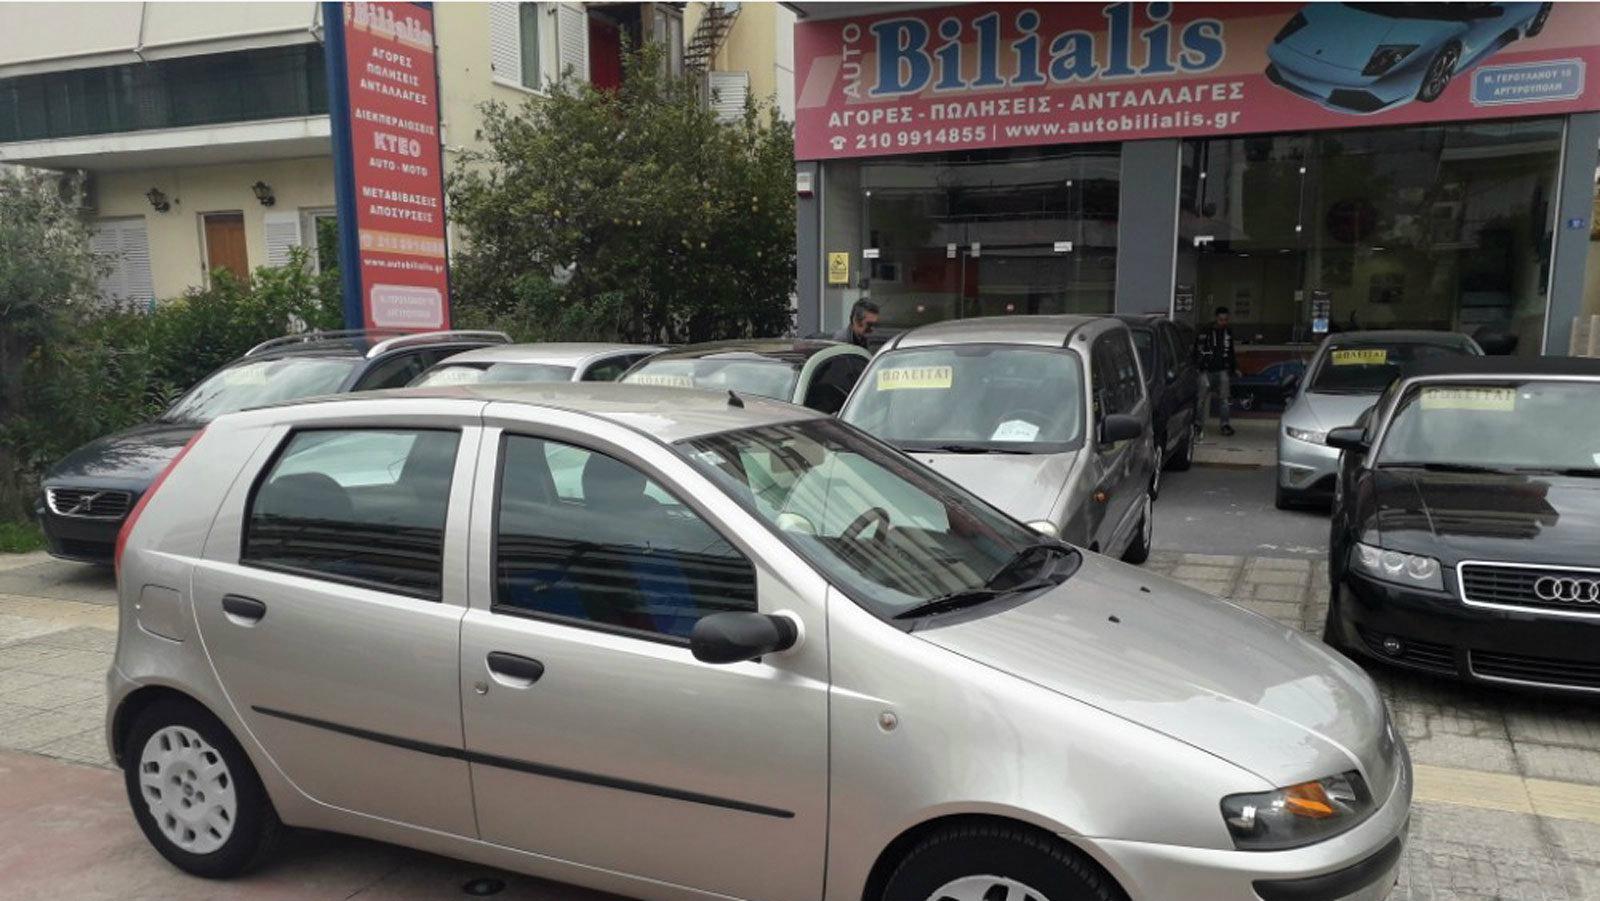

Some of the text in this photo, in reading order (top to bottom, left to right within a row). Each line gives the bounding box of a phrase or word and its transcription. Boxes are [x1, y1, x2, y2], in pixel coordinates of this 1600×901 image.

[372, 47, 412, 68] ΑΓΟΡΕΣ
[843, 23, 861, 99] AUTO
[868, 2, 1226, 96] Bilialis
[367, 63, 418, 86] ΠΩΛΗΣΕΙΣ
[361, 78, 427, 105] ΑΝΤΑΛΛΑΓΕΣ
[1493, 82, 1562, 96] ΑΡΓΥΡΟΥΠΟΛΗ
[828, 107, 913, 127] ΑΓΟΡΕΣ
[930, 96, 1050, 120] ΠΩΛΗΣΕΙΣ
[1070, 82, 1245, 111] ΑΝΤΑΛΛΑΓΕΣ
[355, 108, 435, 135] ΔΙΕΚΠΕΡΑΙΩΣΕΙΣ
[855, 111, 1241, 149] 210 9914855 www.autobilialis.gr
[374, 131, 421, 157] ΚΤΕΟ
[362, 186, 437, 207] ΜΕΤΑΒΙΒΑΣΕΙΣ
[370, 205, 432, 222] ΑΠΟΣΥΡΣΕΙΣ
[882, 368, 950, 382] ΠΩΛΕΙΤΑΙ
